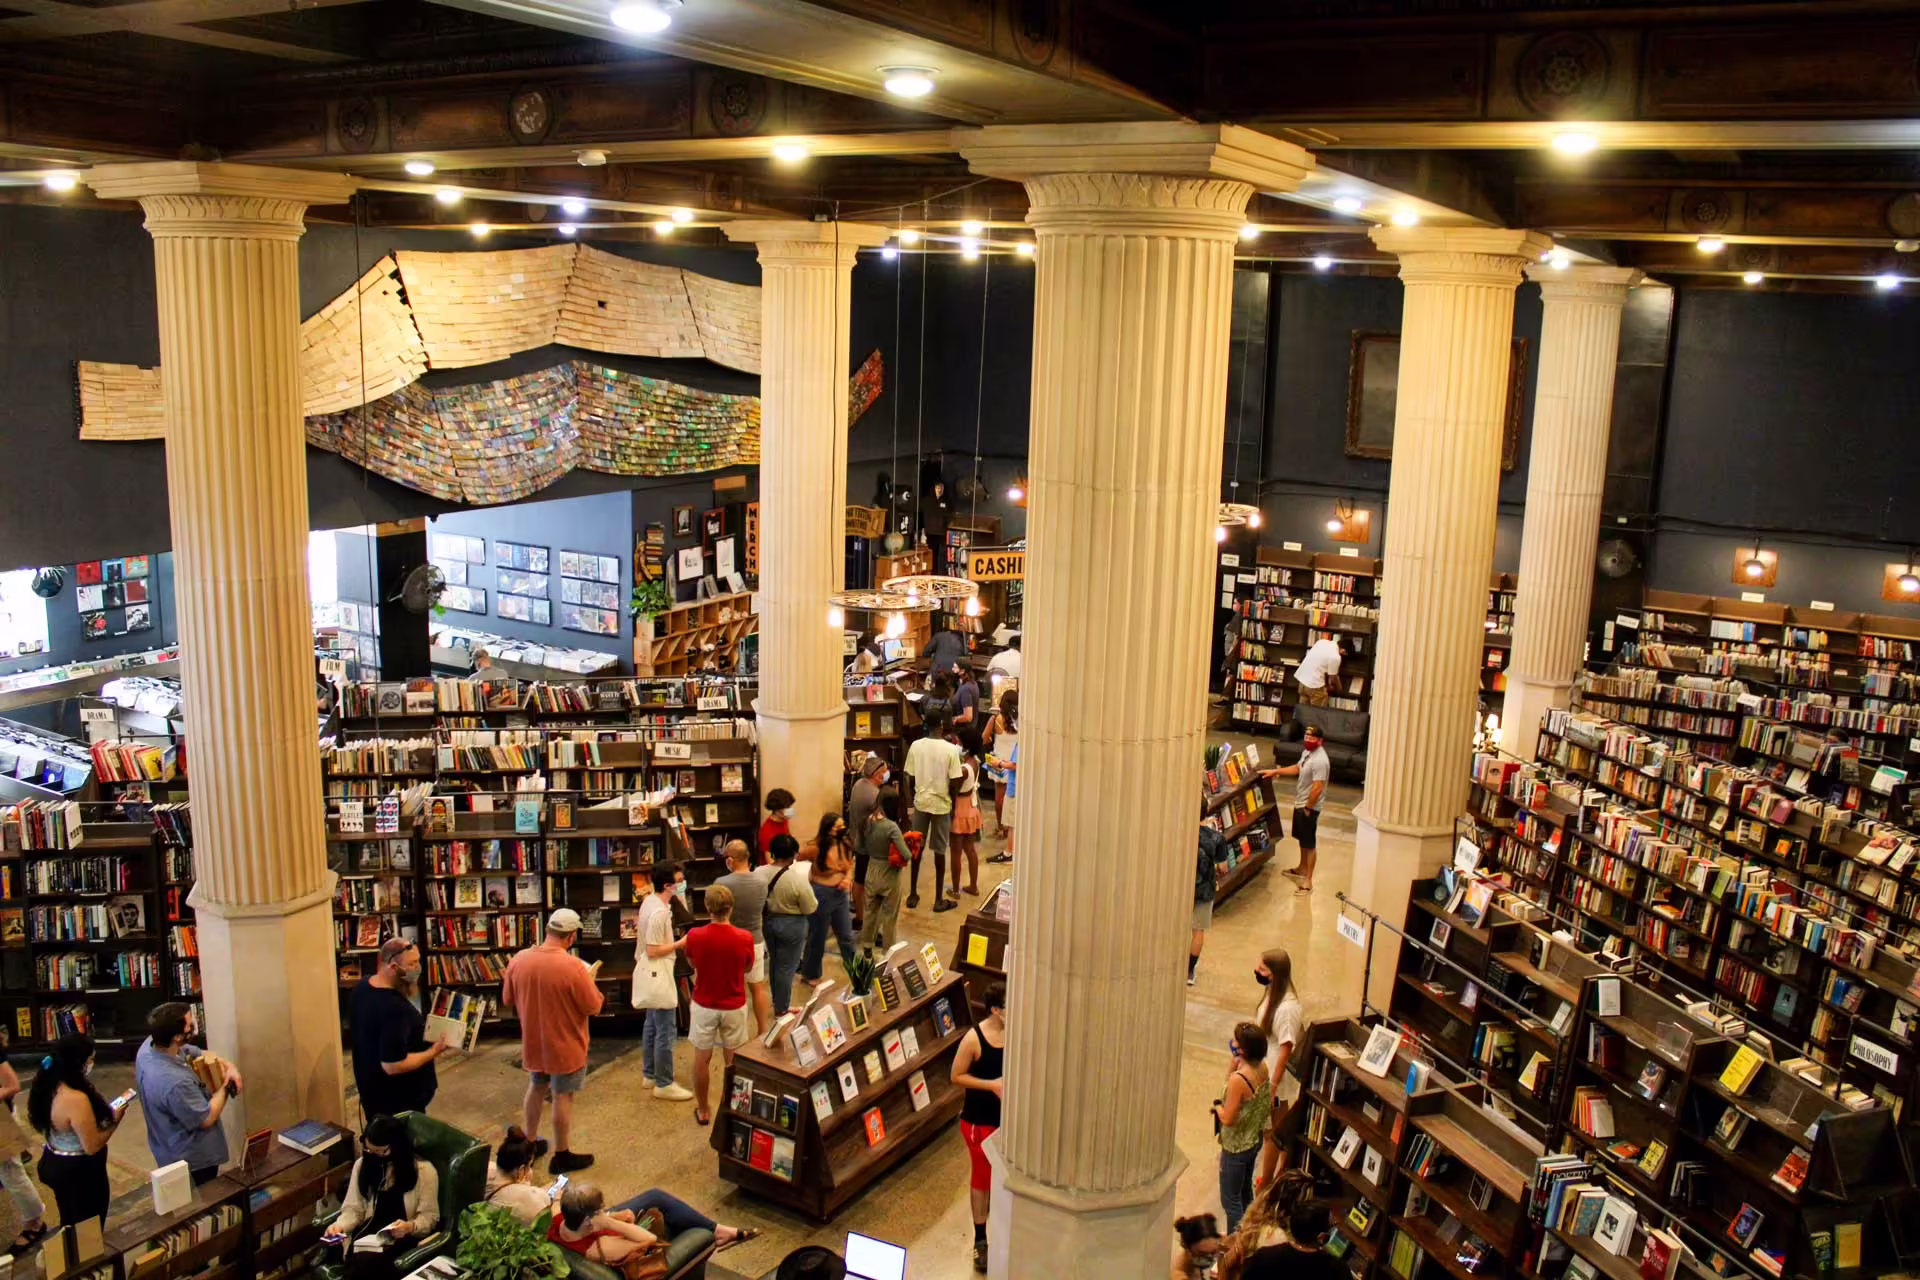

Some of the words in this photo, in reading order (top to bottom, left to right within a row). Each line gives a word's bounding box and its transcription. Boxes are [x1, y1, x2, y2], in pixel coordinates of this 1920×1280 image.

[749, 507, 757, 568] MERCH
[975, 557, 1024, 575] CASHI
[703, 699, 722, 708] DRAMA
[87, 712, 108, 720] DRAMA
[1853, 1042, 1892, 1070] PHILOSOPHY
